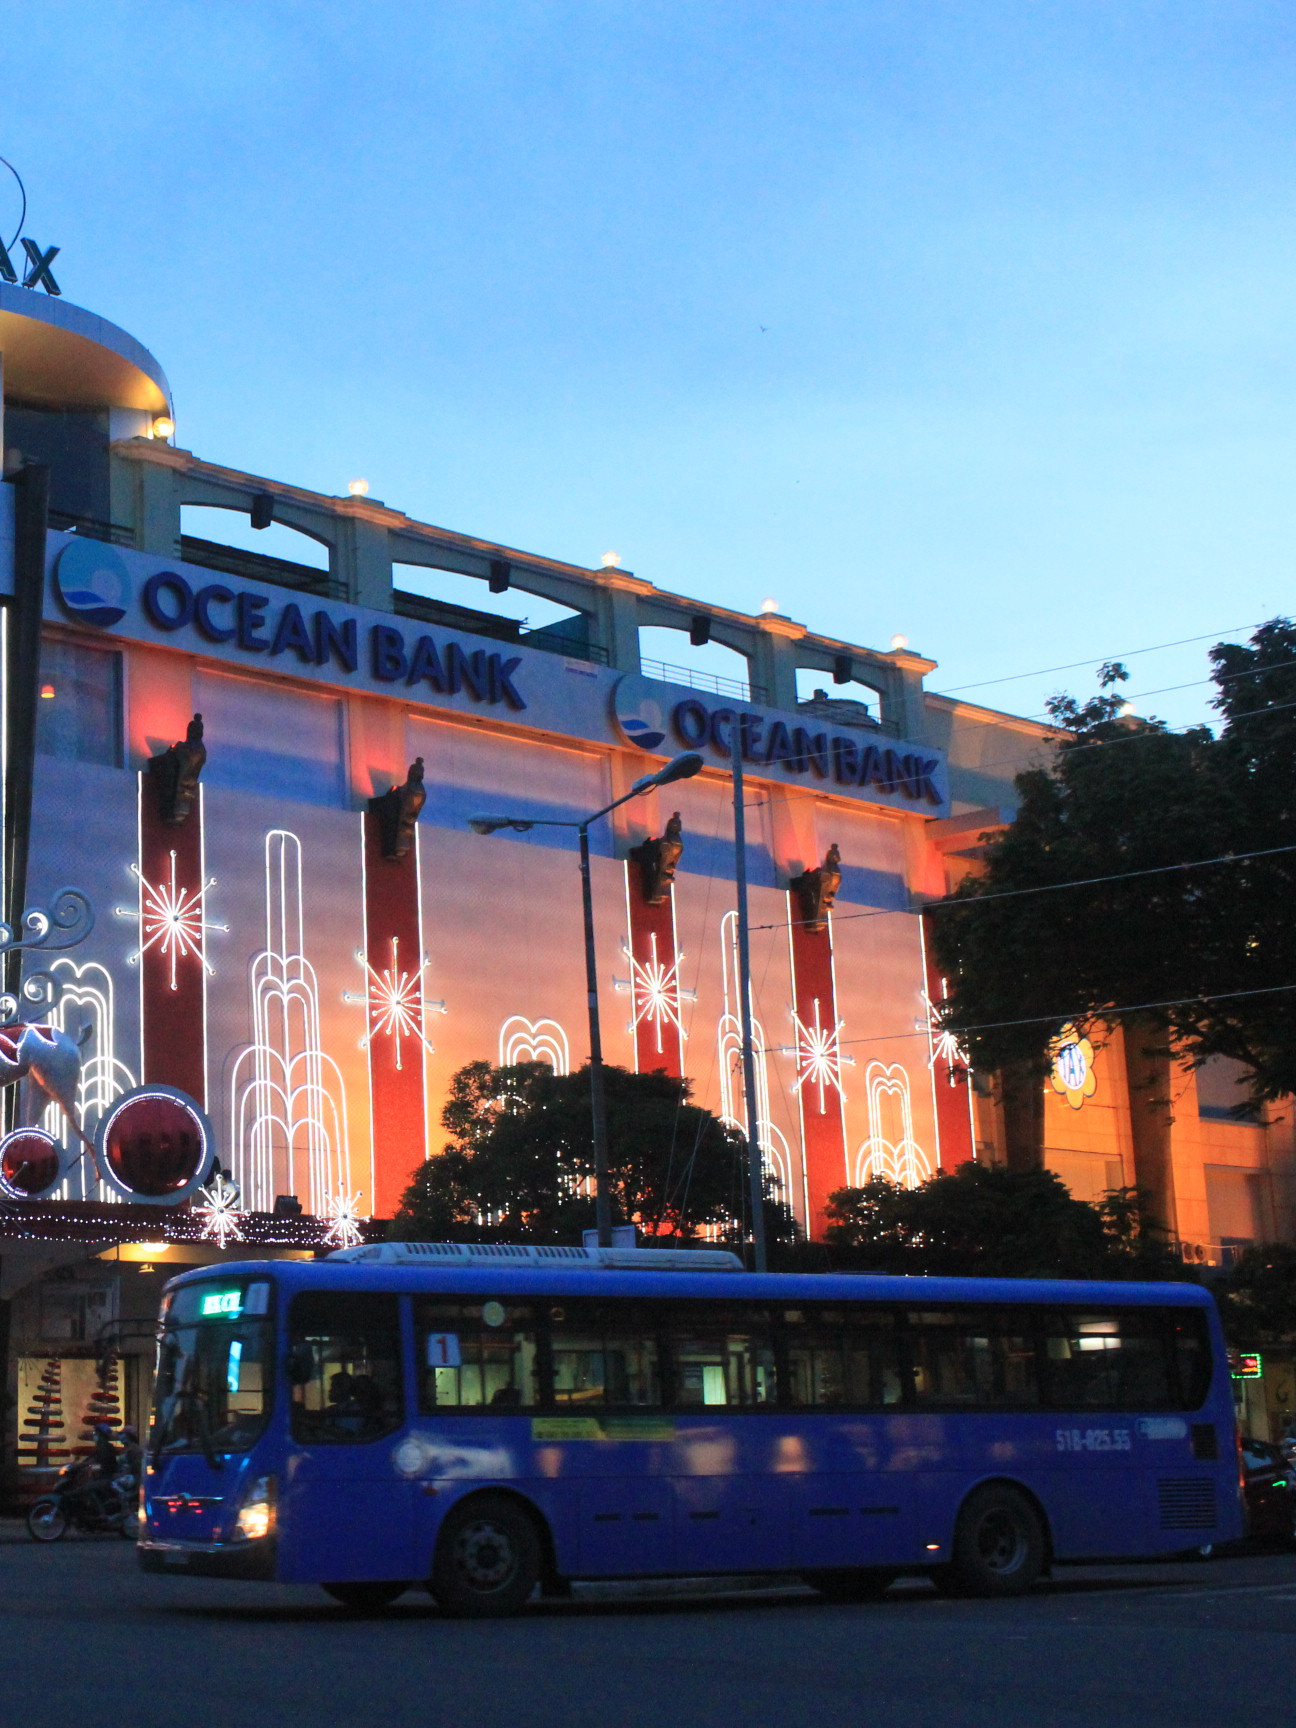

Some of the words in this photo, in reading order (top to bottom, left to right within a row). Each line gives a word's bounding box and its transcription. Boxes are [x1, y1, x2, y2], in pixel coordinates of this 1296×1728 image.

[142, 570, 359, 673] OCEAN
[371, 622, 528, 711] BANK
[670, 699, 831, 780] OCEAN
[832, 735, 944, 805] BANK
[437, 1336, 449, 1364] 1
